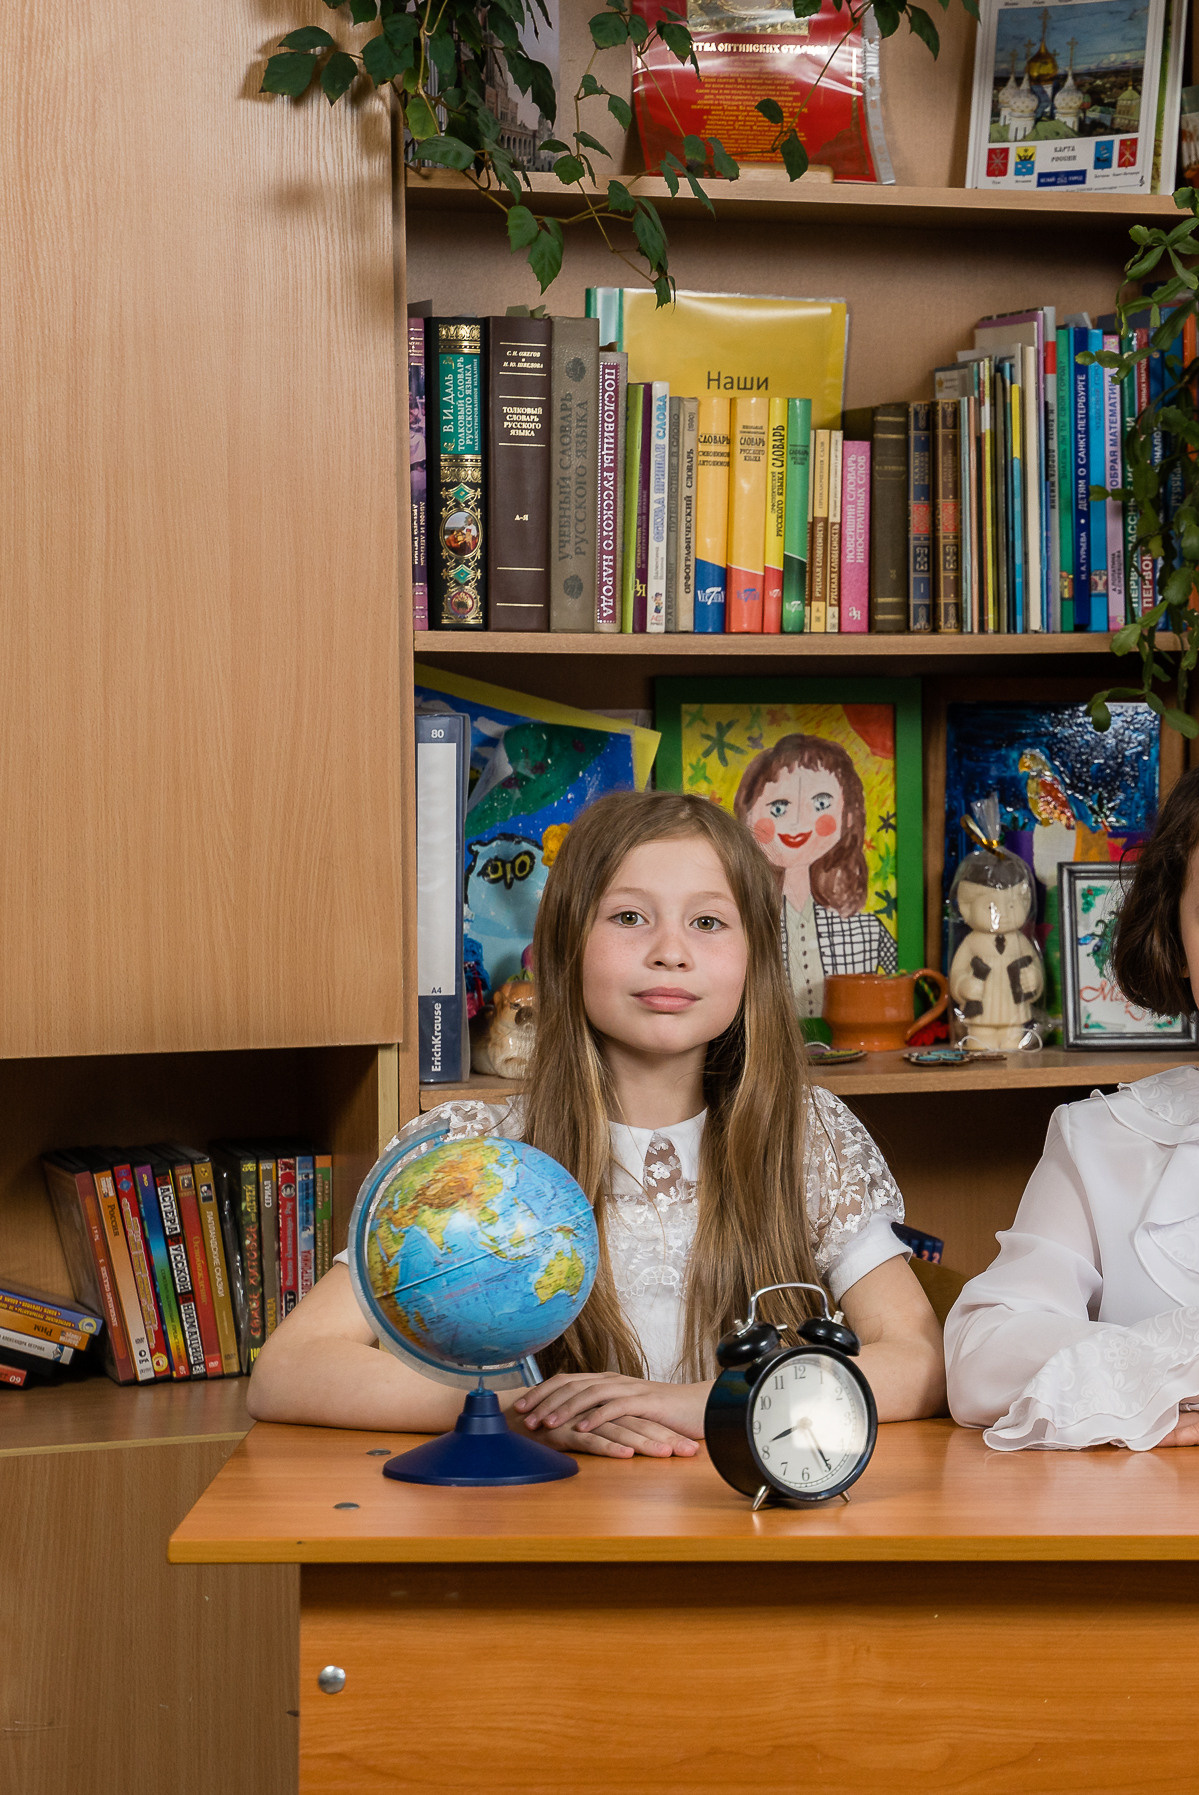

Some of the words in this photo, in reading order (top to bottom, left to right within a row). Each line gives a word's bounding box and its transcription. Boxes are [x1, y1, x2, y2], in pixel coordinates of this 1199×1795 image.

[717, 43, 780, 54] ОПТИНСКИХ
[442, 373, 455, 405] Даль
[455, 356, 465, 398] СЛОВАРЬ
[464, 363, 472, 396] ЯЗЫКА
[706, 370, 768, 391] Наши
[1058, 360, 1067, 392] ГОРОД?
[442, 405, 454, 420] И.
[442, 421, 454, 433] В.
[455, 400, 465, 452] ТОЛКОВЫЙ
[465, 397, 473, 445] РУССКОГО
[502, 406, 543, 415] ТОЛКОВЫЙ
[503, 421, 541, 430] РУССКОГО
[506, 414, 539, 422] СЛОВАРЬ
[602, 369, 617, 468] ПОСЛОВИЦЫ
[654, 394, 667, 440] СЛОВА
[1076, 374, 1087, 464] САНКТ-ПЕТЕРБУРГЕ
[509, 429, 535, 437] ЯЗЫКА
[558, 392, 573, 471] СЛОВАРЬ
[574, 399, 589, 459] ЯЗЫКА
[740, 436, 766, 447] СЛОВАРЬ
[771, 425, 785, 468] СЛОВАРЬ
[654, 444, 666, 494] ПРИШЛИ
[685, 449, 695, 489] СЛОВАРЬ
[776, 471, 785, 496] ЯЗЫКА
[846, 454, 857, 501] СЛОВАРЬ
[857, 455, 868, 484] СЛОВ
[1077, 467, 1086, 476] О
[1108, 450, 1119, 490] ОБРАЯ
[574, 465, 589, 556] РУССКОГО
[602, 471, 616, 551] РУССКОГО
[1077, 480, 1088, 511] ДЕТЯМ
[556, 476, 574, 562] УЧЕБНЫЙ
[653, 497, 666, 543] ОТКУДА
[776, 500, 784, 538] РУССКОГО
[845, 504, 857, 563] НОВЕЙШИЙ
[856, 487, 867, 563] ИНОСТРАННЫХ
[683, 495, 693, 595] ОРФОГРАФИЧЕСКИЙ
[1079, 532, 1088, 564] ГУРЬЕВА
[601, 554, 616, 617] НАРОДА
[430, 728, 444, 739] 80
[430, 986, 442, 995] A4
[430, 1002, 443, 1073] ErichKrause
[156, 1176, 181, 1237] МАСТЕРА
[264, 1180, 272, 1208] СЕРИАЛ
[107, 1203, 120, 1238] Россия
[206, 1210, 221, 1267] ЛАПЛАНДСКИЕ
[192, 1235, 208, 1305] Освобождение
[213, 1265, 225, 1298] СКАЗКИ
[33, 1324, 53, 1337] Рим
[774, 1375, 785, 1390] 11
[793, 1365, 807, 1380] 12
[759, 1395, 772, 1411] 10
[834, 1386, 844, 1401] 2
[753, 1421, 762, 1434] 9
[761, 1445, 771, 1460] 8
[780, 1461, 789, 1476] 7
[801, 1467, 811, 1482] 6
